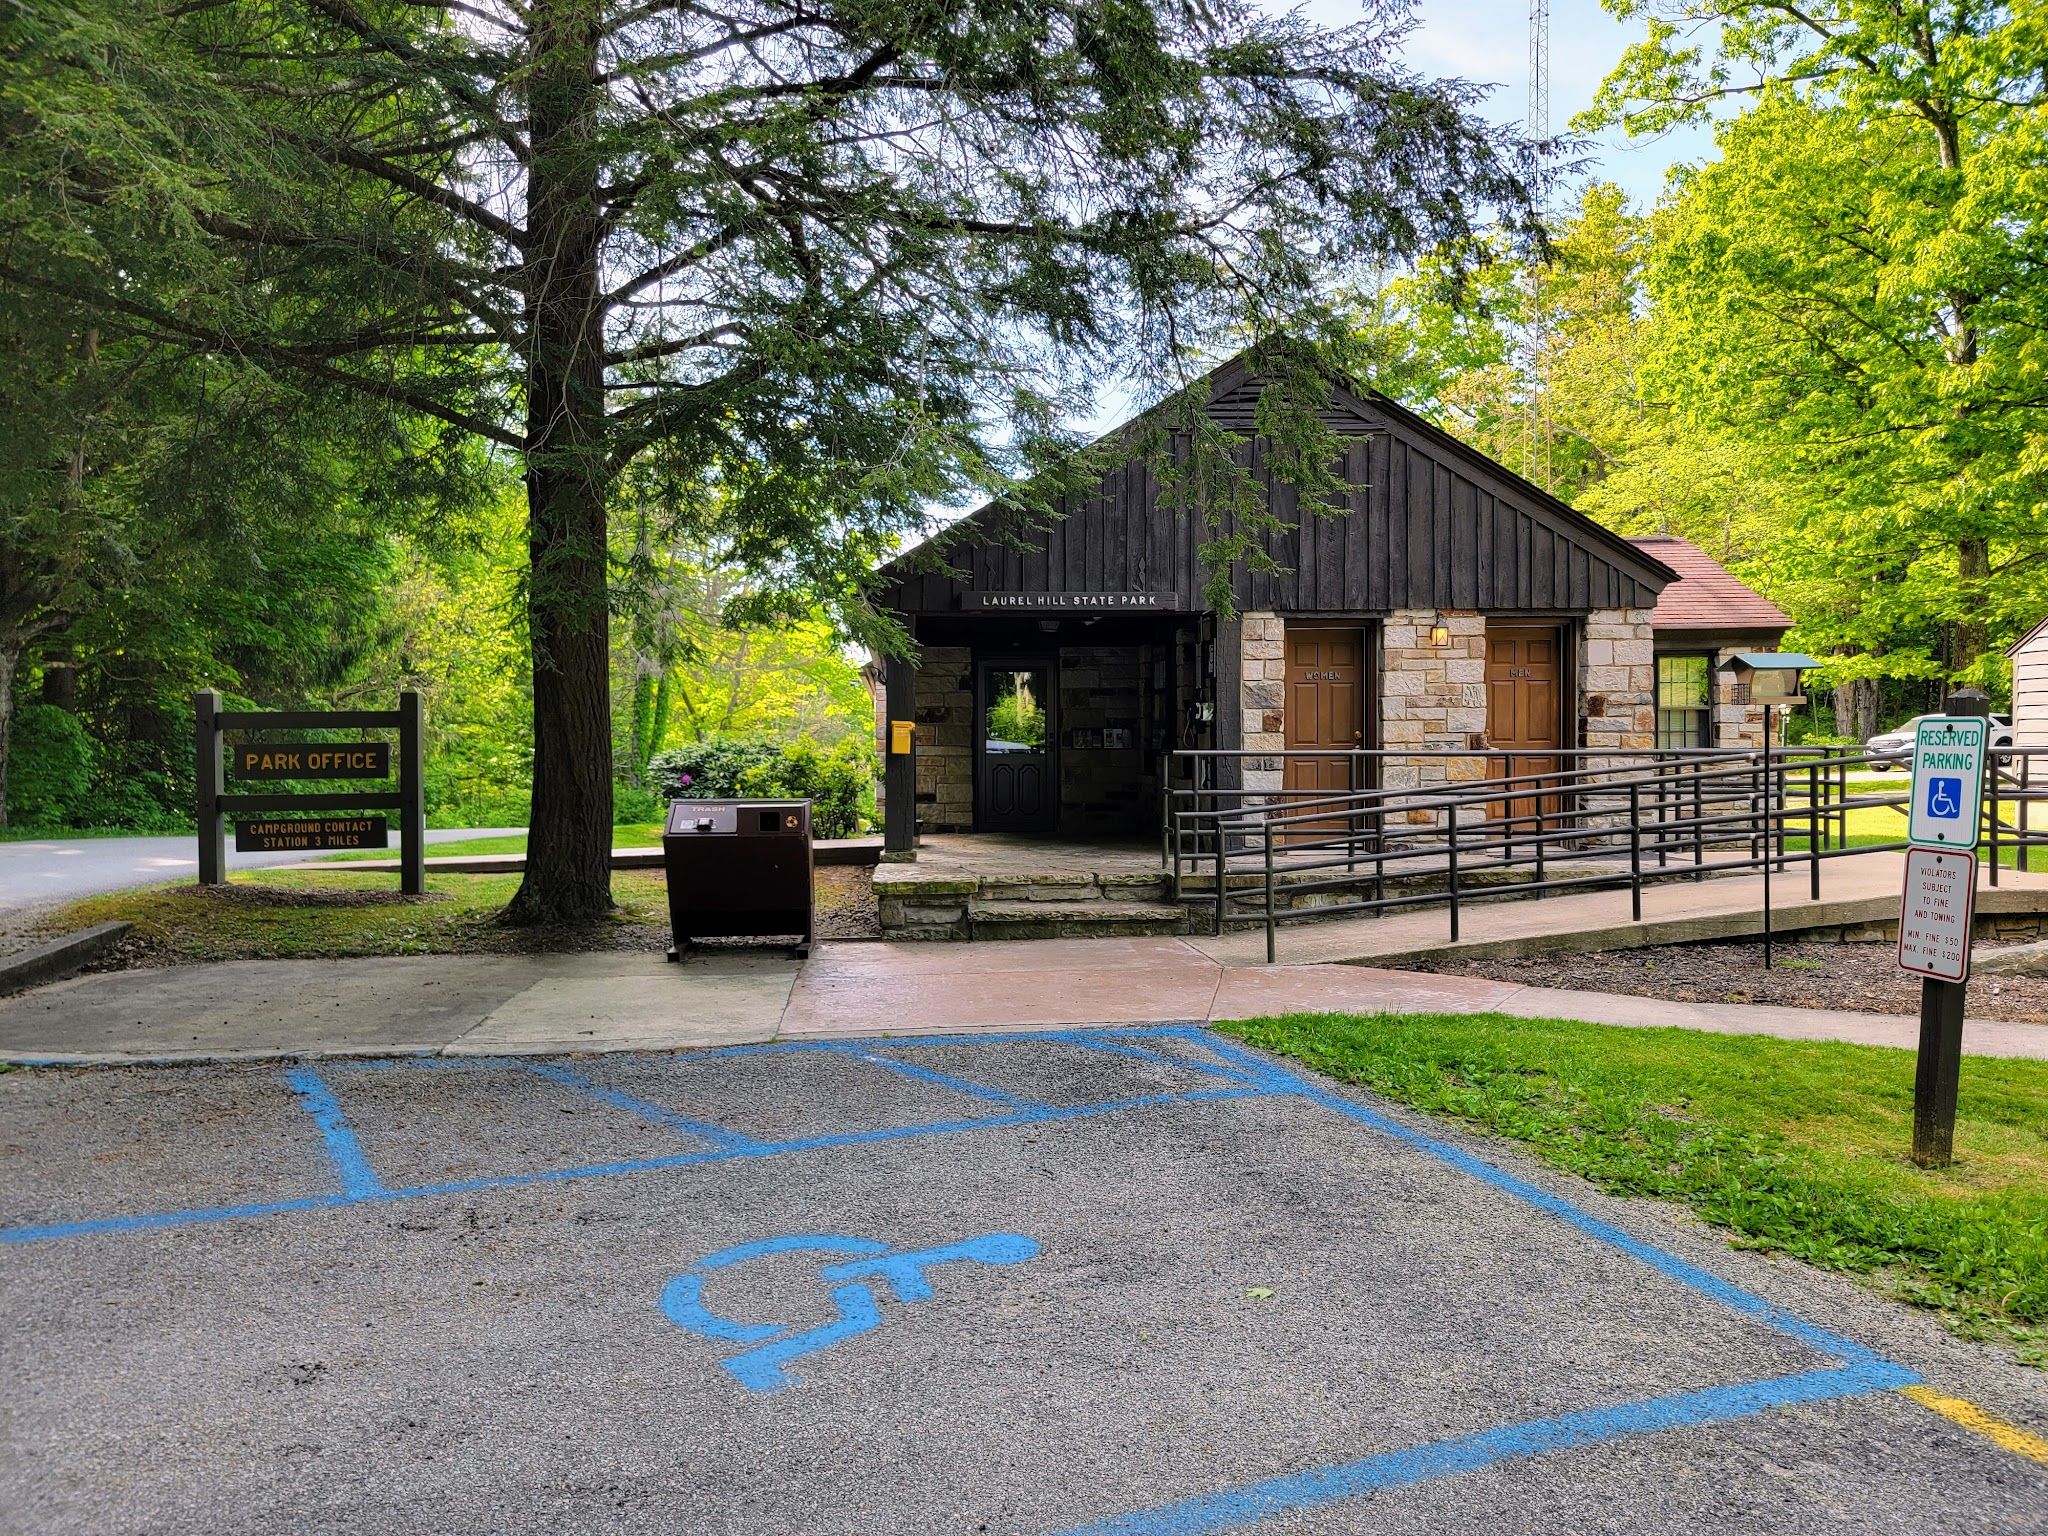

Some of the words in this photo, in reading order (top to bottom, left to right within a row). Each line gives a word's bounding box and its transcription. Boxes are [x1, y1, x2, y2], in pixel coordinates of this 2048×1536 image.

[983, 596, 1032, 605] LAUREL
[1038, 596, 1066, 605] HILL
[1073, 596, 1114, 605] STATE
[1121, 596, 1156, 605] PARK
[1305, 671, 1341, 681] WOMEN
[1510, 668, 1531, 678] MEN
[1920, 730, 1979, 747] RESERVED
[246, 753, 301, 770] PARK
[308, 752, 377, 769] OFFICE
[1922, 752, 1973, 771] PARKING
[250, 822, 321, 835] CAMPGROUND
[325, 821, 373, 832] CONTACT
[263, 836, 308, 848] STATION
[315, 836, 321, 846] 3
[328, 835, 360, 846] MILES
[1920, 867, 1957, 880] VIOLATORS
[1922, 882, 1952, 893] SUBJECT
[1923, 896, 1931, 905] TO
[1933, 899, 1949, 908] FINE
[1914, 910, 1928, 919] AND
[1931, 912, 1955, 923] TOWING
[1907, 930, 1921, 940] MIN.
[1925, 933, 1940, 943] FINE
[1945, 936, 1959, 947] $50
[1903, 943, 1919, 954] MAX.
[1922, 946, 1937, 957] FINE
[1942, 950, 1960, 962] $200
